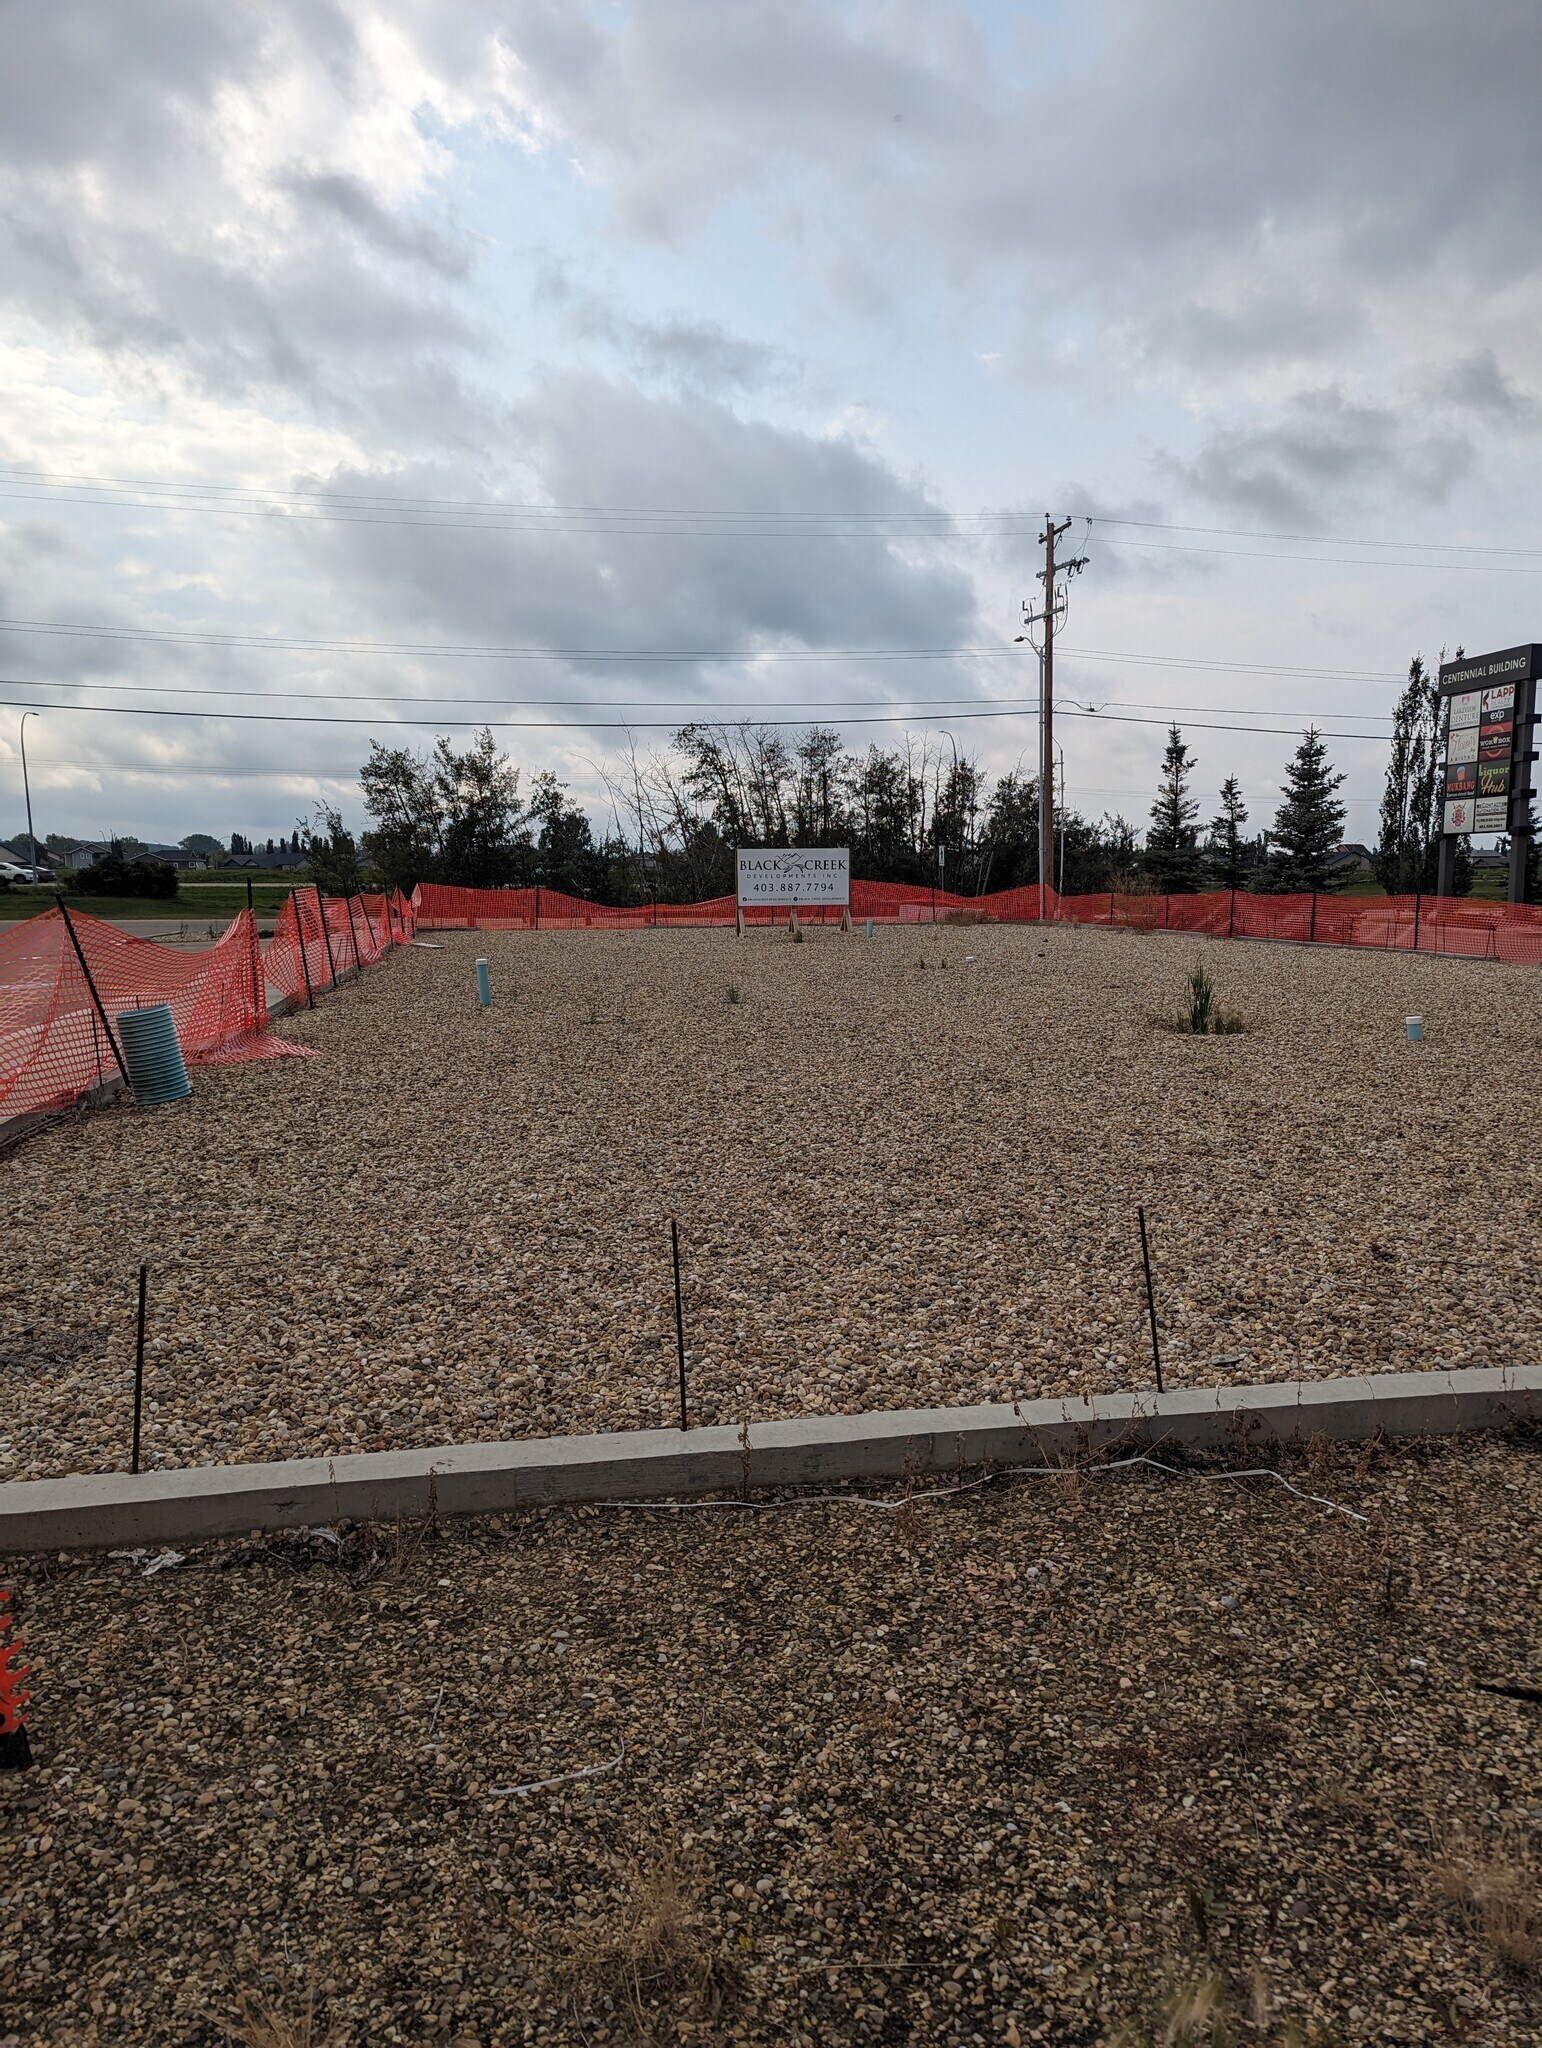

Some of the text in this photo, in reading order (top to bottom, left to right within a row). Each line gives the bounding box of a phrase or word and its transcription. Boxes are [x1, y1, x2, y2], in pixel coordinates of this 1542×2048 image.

[1442, 657, 1527, 684] CENTENNIAL BUILDING
[1491, 686, 1515, 700] LAPP
[1451, 712, 1480, 724] DENTURE
[1478, 765, 1509, 777] Liquor
[1481, 774, 1505, 794] Hub
[740, 859, 847, 871] BLACK CREEK
[753, 882, 834, 892] 403.887.7794
